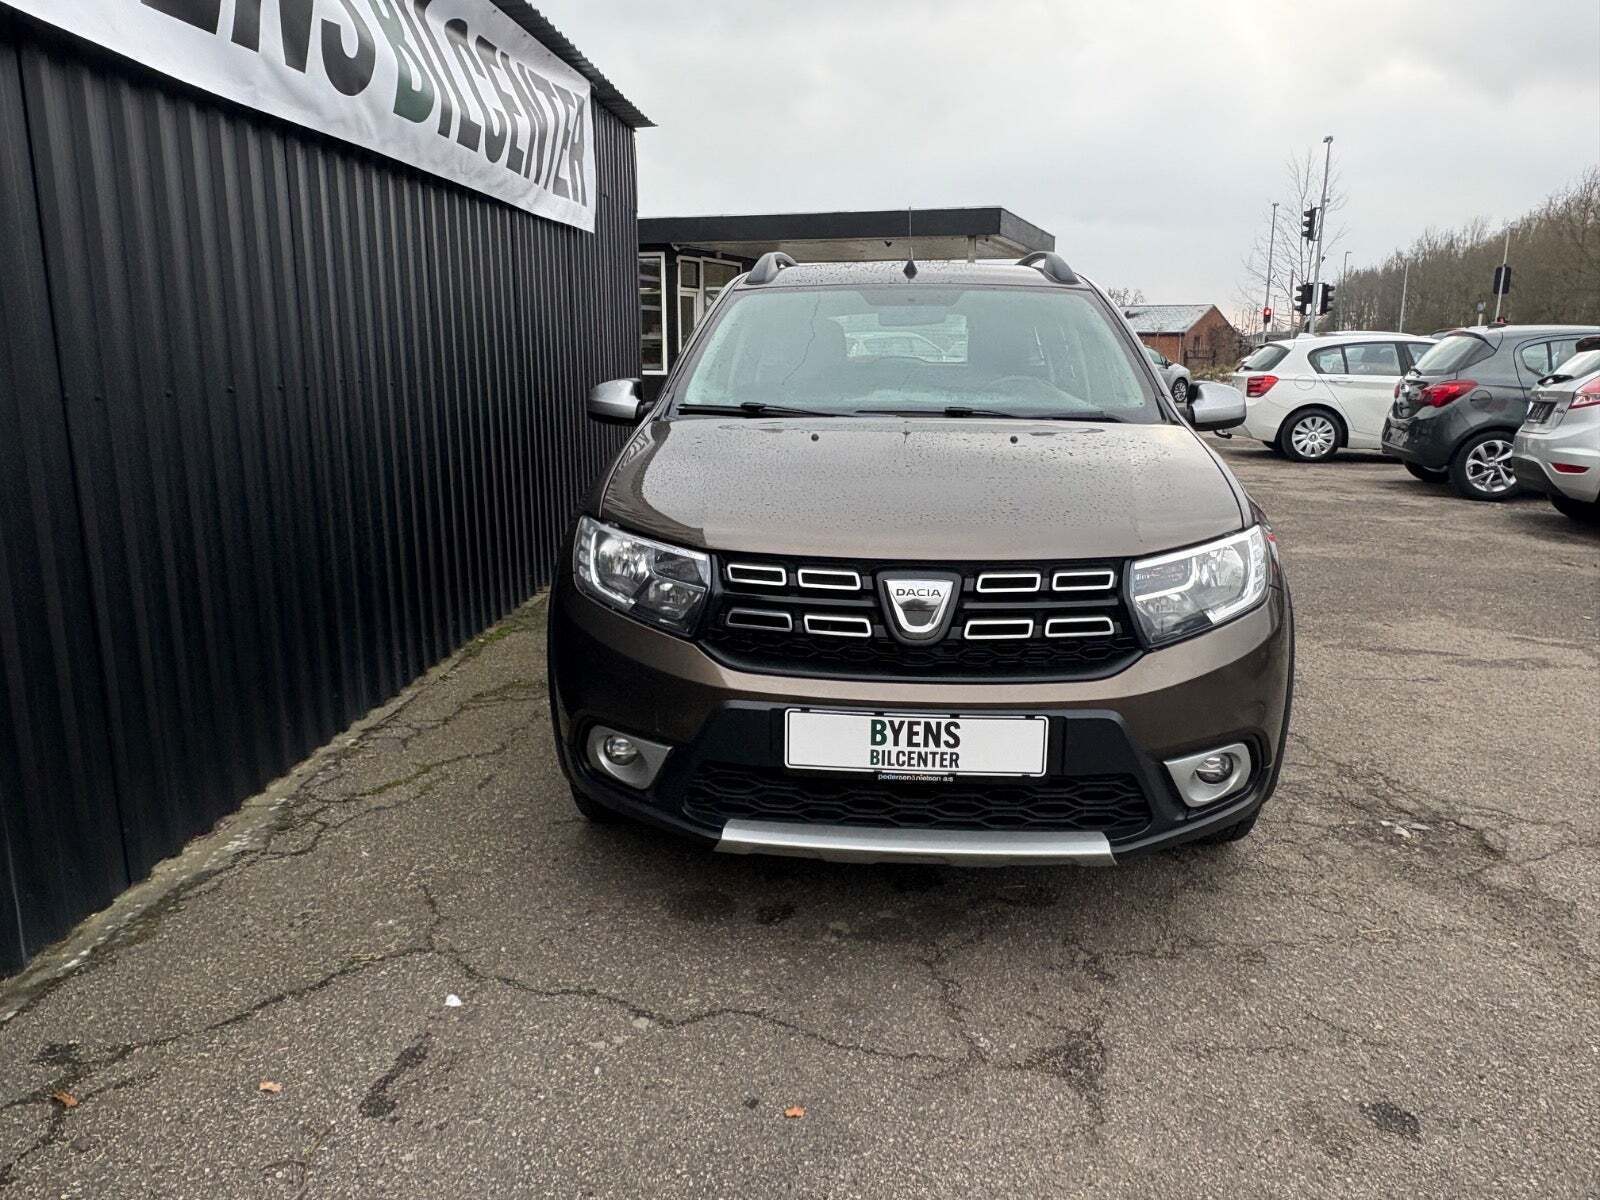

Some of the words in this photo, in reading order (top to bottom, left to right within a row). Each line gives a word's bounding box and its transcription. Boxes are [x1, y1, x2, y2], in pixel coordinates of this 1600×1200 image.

[367, 0, 587, 207] BILCENTER
[896, 588, 941, 597] DACIA
[871, 719, 961, 749] BYENS
[871, 750, 960, 768] BILCENTER
